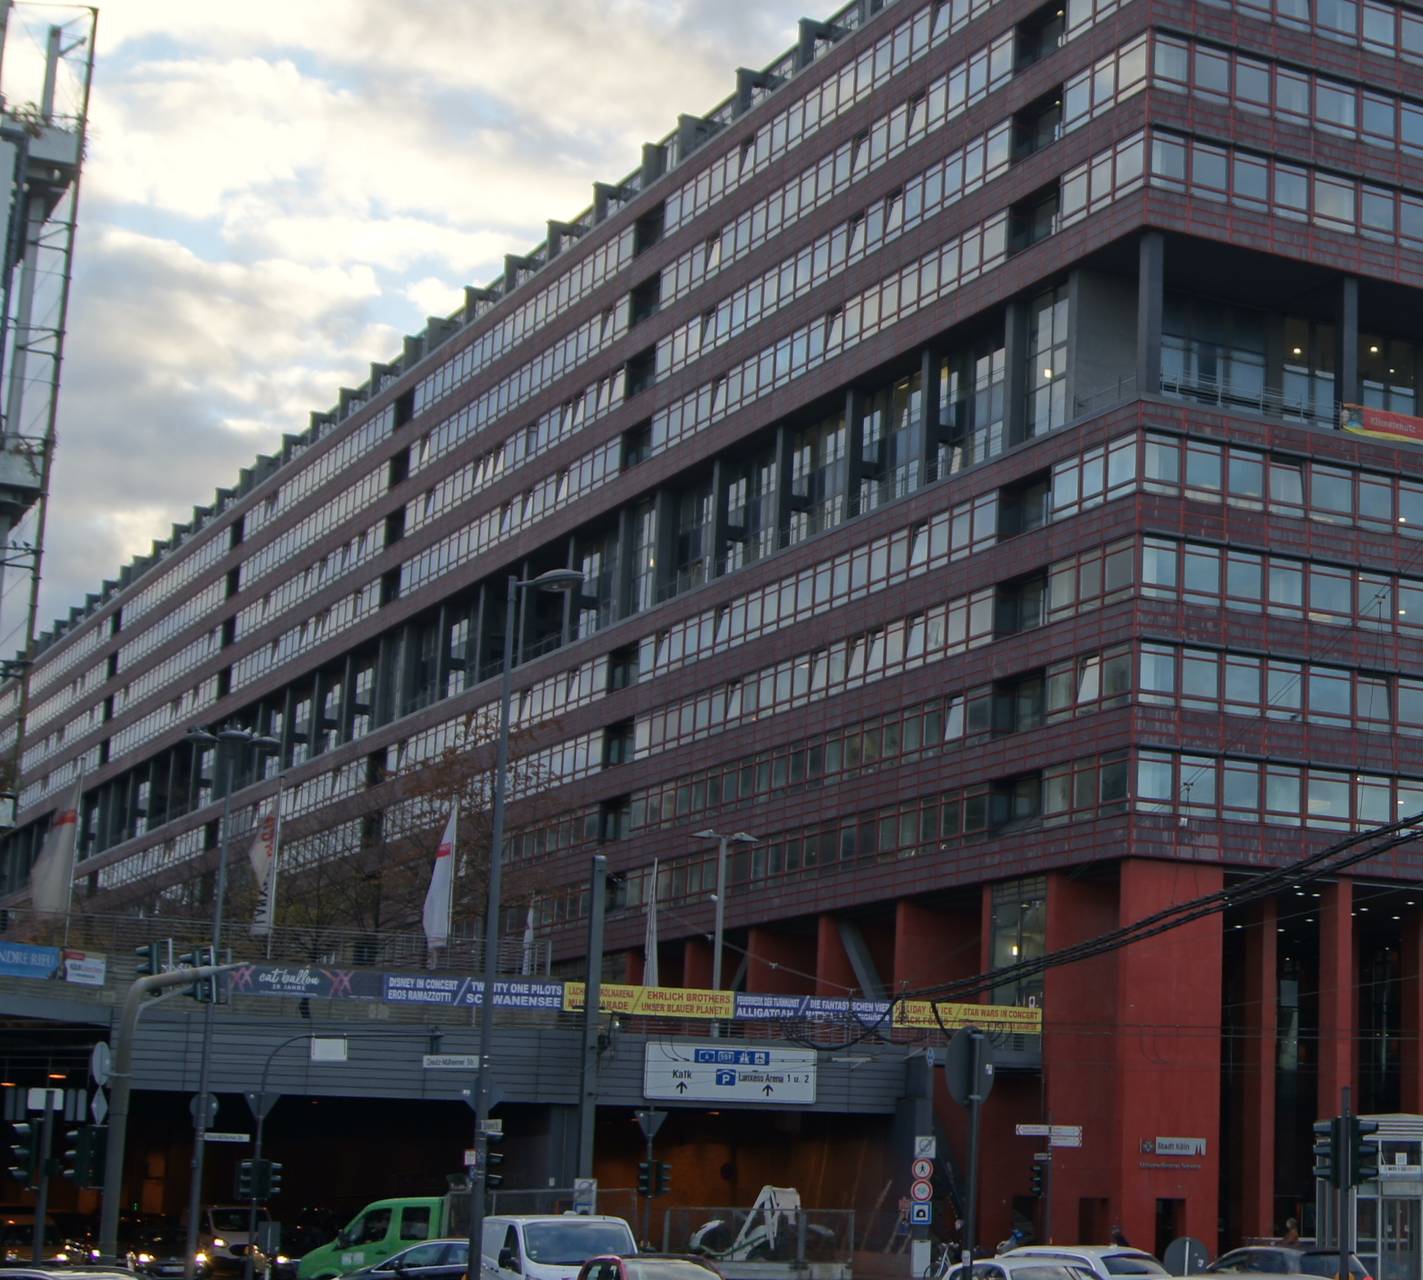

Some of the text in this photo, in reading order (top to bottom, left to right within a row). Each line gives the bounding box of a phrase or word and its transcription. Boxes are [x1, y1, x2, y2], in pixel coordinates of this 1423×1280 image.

[389, 976, 458, 991] DISNEY IN CONCERT
[472, 981, 562, 995] TWTY ONE PILOTS
[388, 990, 407, 1000] EROS
[408, 990, 452, 1002] RAMAZZOTTI
[466, 993, 561, 1008] SCWANENSEE
[647, 990, 731, 1004] EHRLICH BROTHERS
[666, 1003, 694, 1013] BLAUER
[695, 1004, 723, 1015] PLANET
[810, 1000, 821, 1009] DIE
[822, 1000, 874, 1012] FANTASTSCHEN
[1008, 1010, 1038, 1020] CONCERT
[672, 1069, 692, 1079] Kalk
[765, 1073, 784, 1083] Arena
